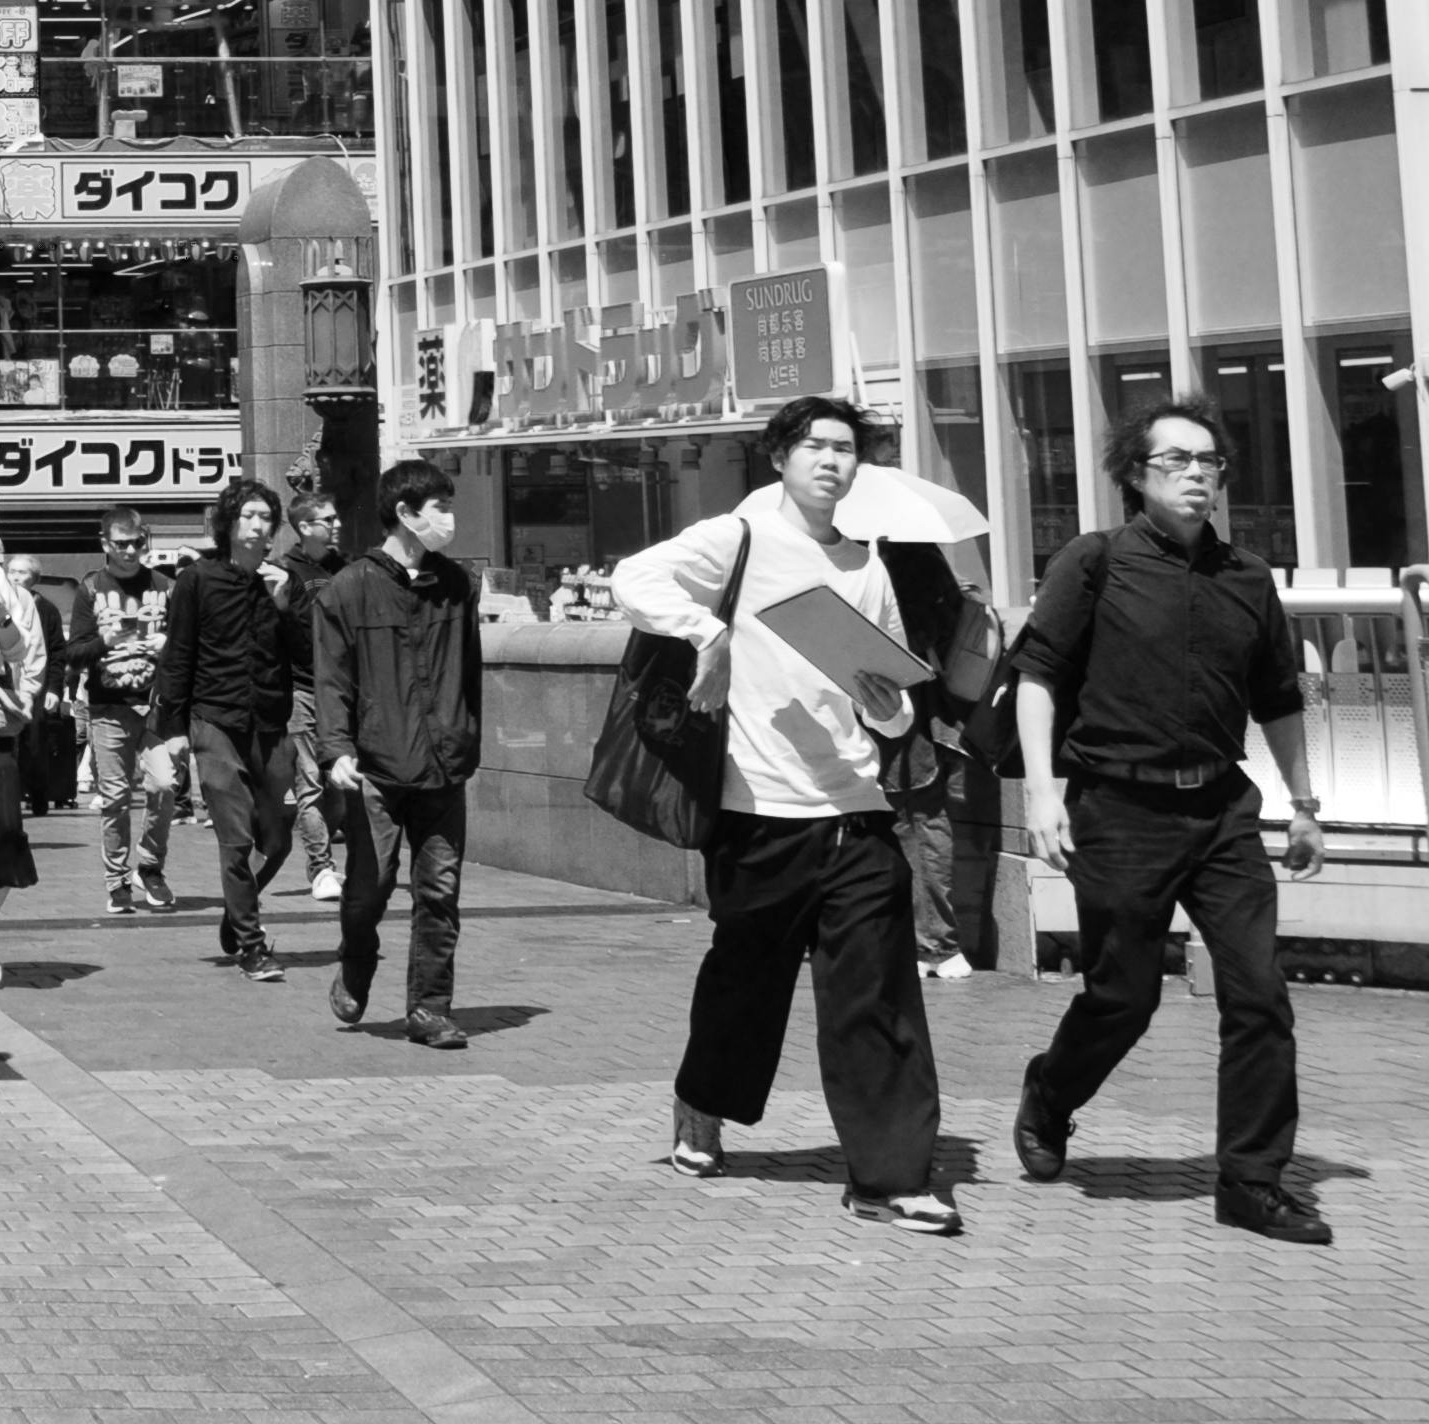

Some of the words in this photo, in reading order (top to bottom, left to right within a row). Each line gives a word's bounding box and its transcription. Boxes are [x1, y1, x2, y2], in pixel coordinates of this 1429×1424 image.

[74, 168, 239, 211] ダイコク
[746, 279, 813, 311] SUNDRUG
